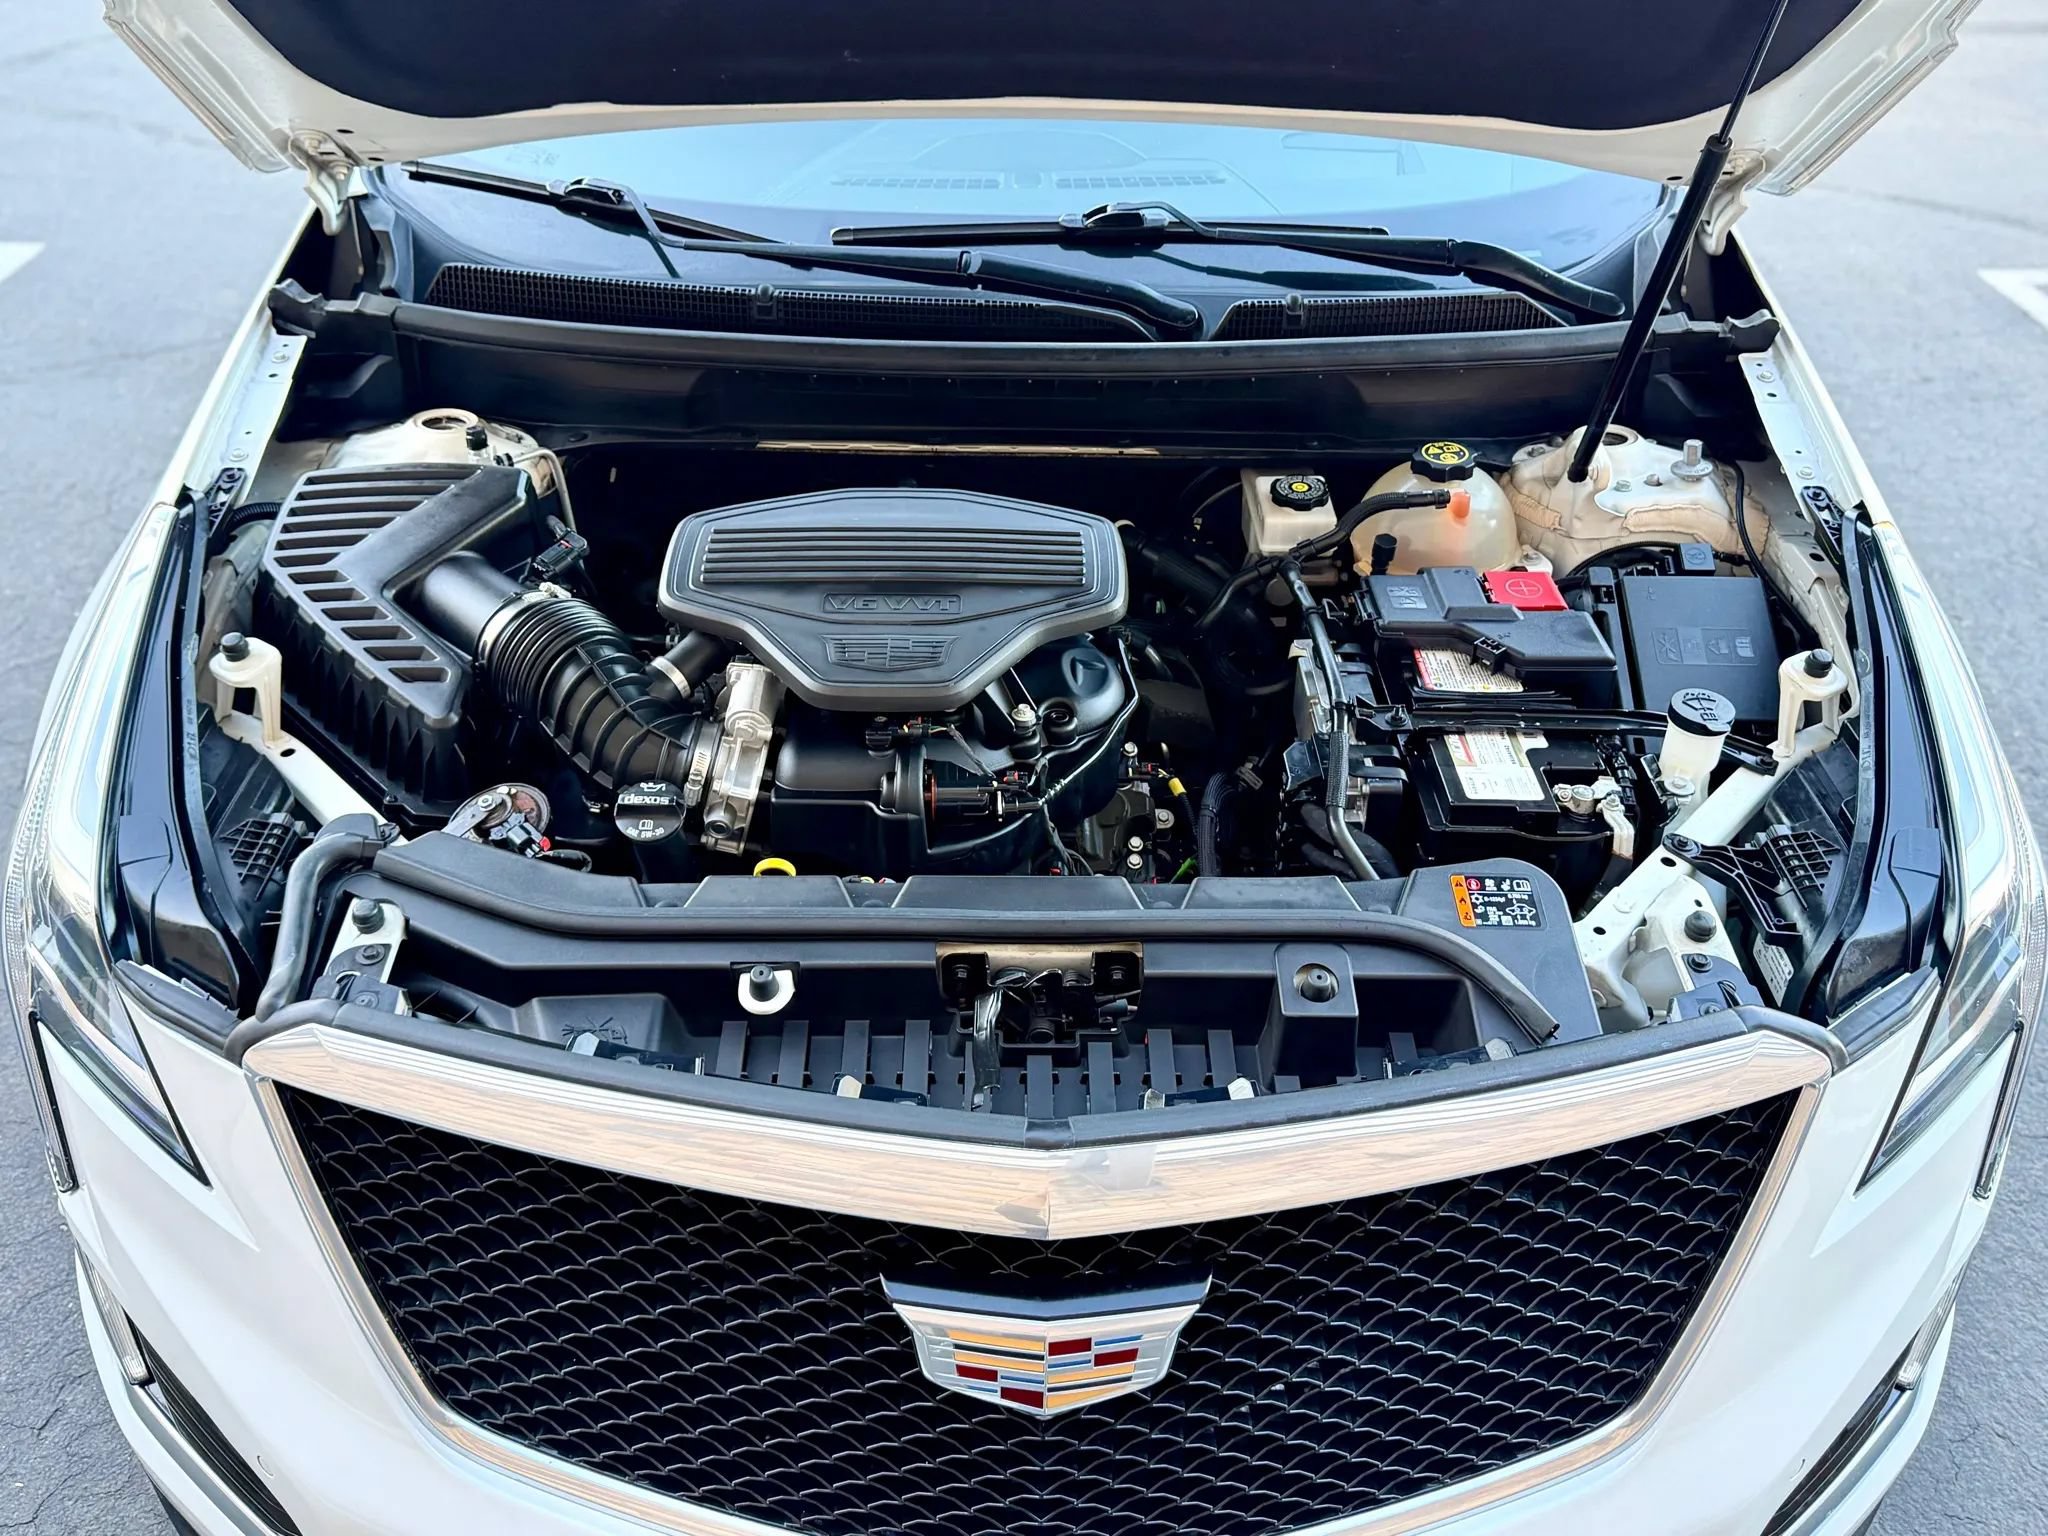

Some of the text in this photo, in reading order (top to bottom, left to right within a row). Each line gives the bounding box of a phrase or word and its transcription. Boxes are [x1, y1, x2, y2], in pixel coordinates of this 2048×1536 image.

[828, 596, 958, 611] V6 VVT
[624, 793, 670, 805] dexos
